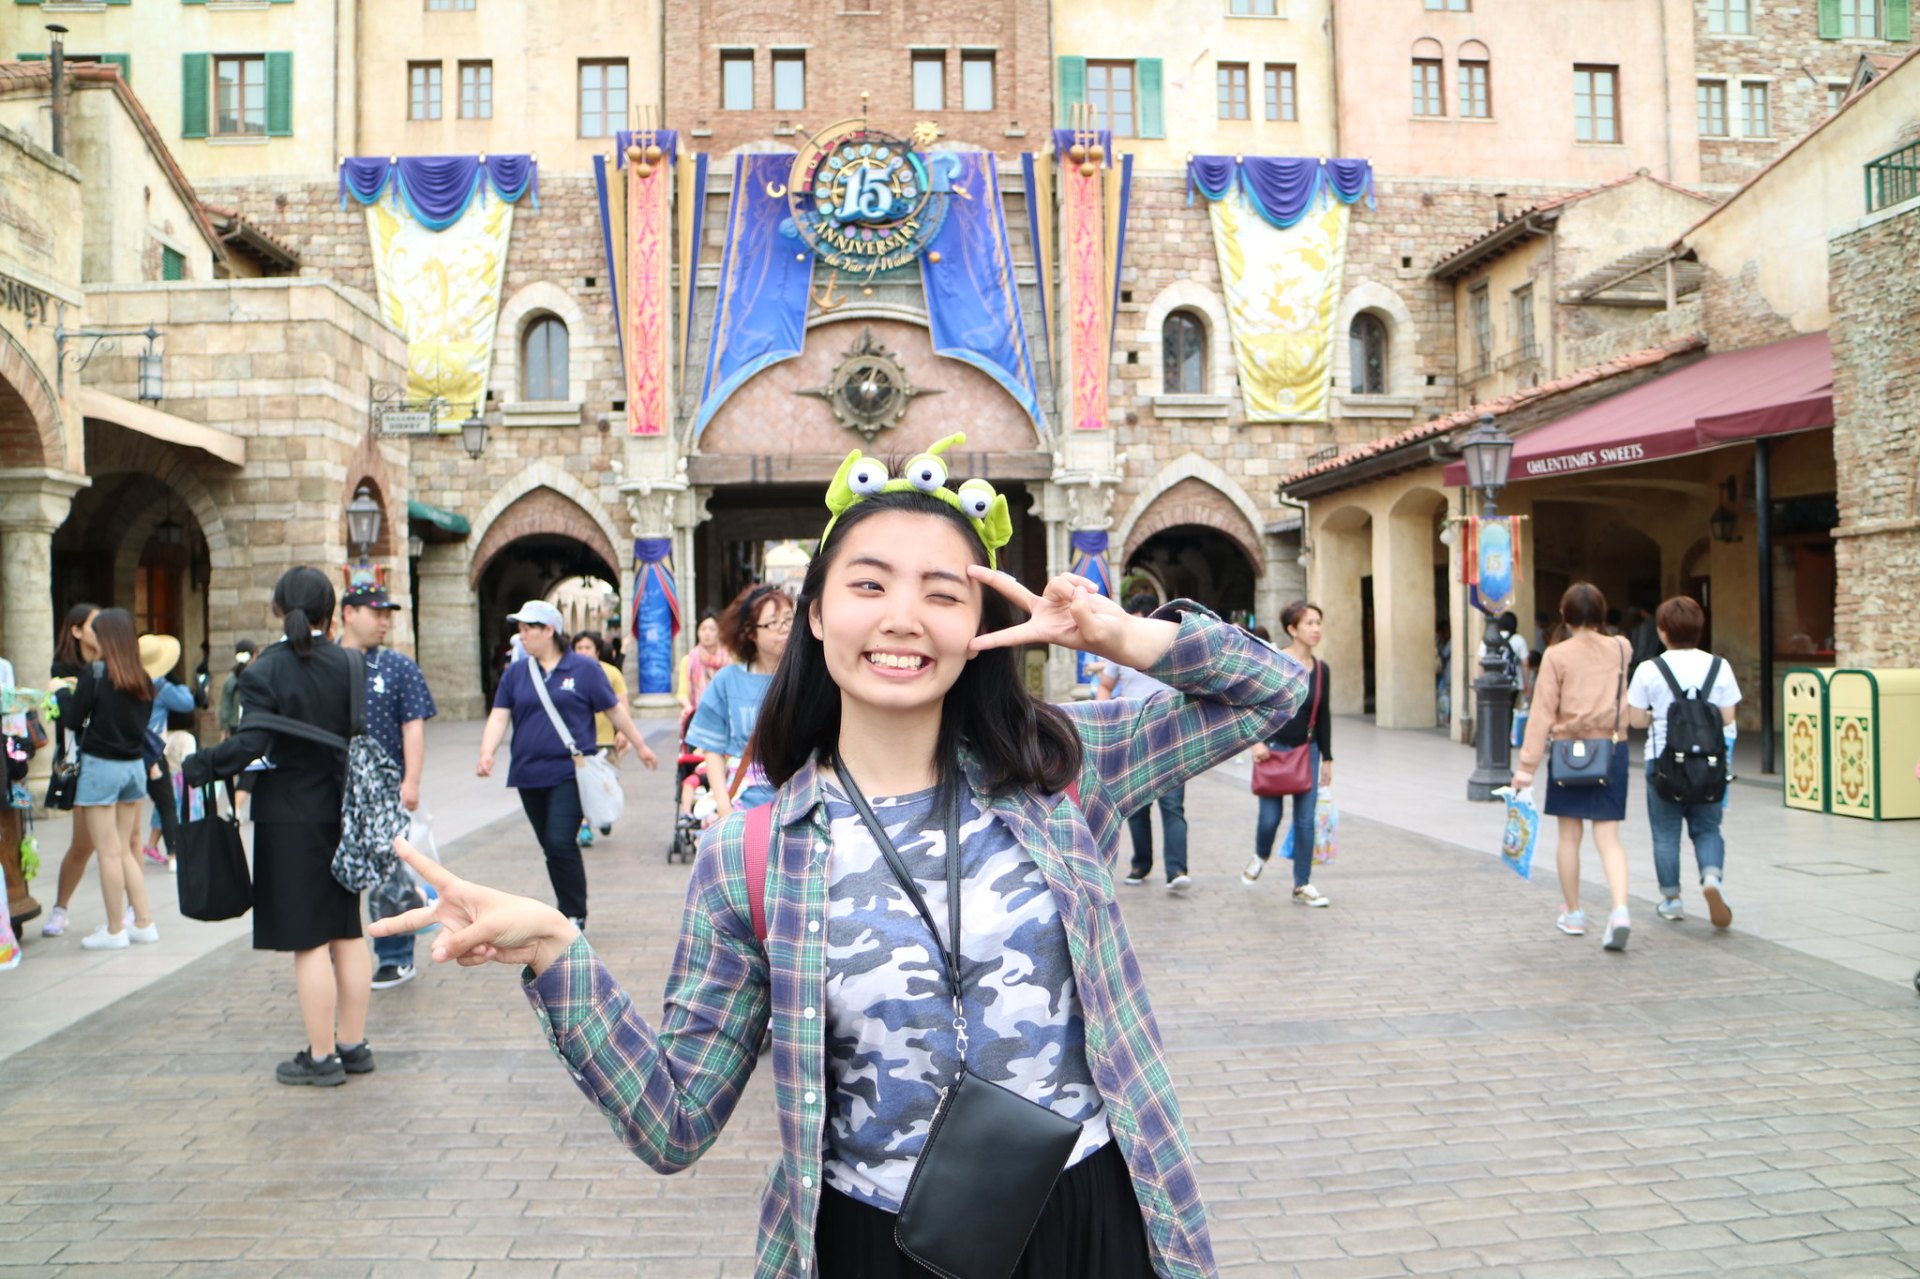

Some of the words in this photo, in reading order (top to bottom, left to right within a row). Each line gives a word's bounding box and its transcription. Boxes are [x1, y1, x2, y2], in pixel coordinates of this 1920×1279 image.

[833, 165, 894, 219] 15
[813, 219, 920, 256] ANNIVERSARY
[1600, 443, 1645, 463] SWEETS
